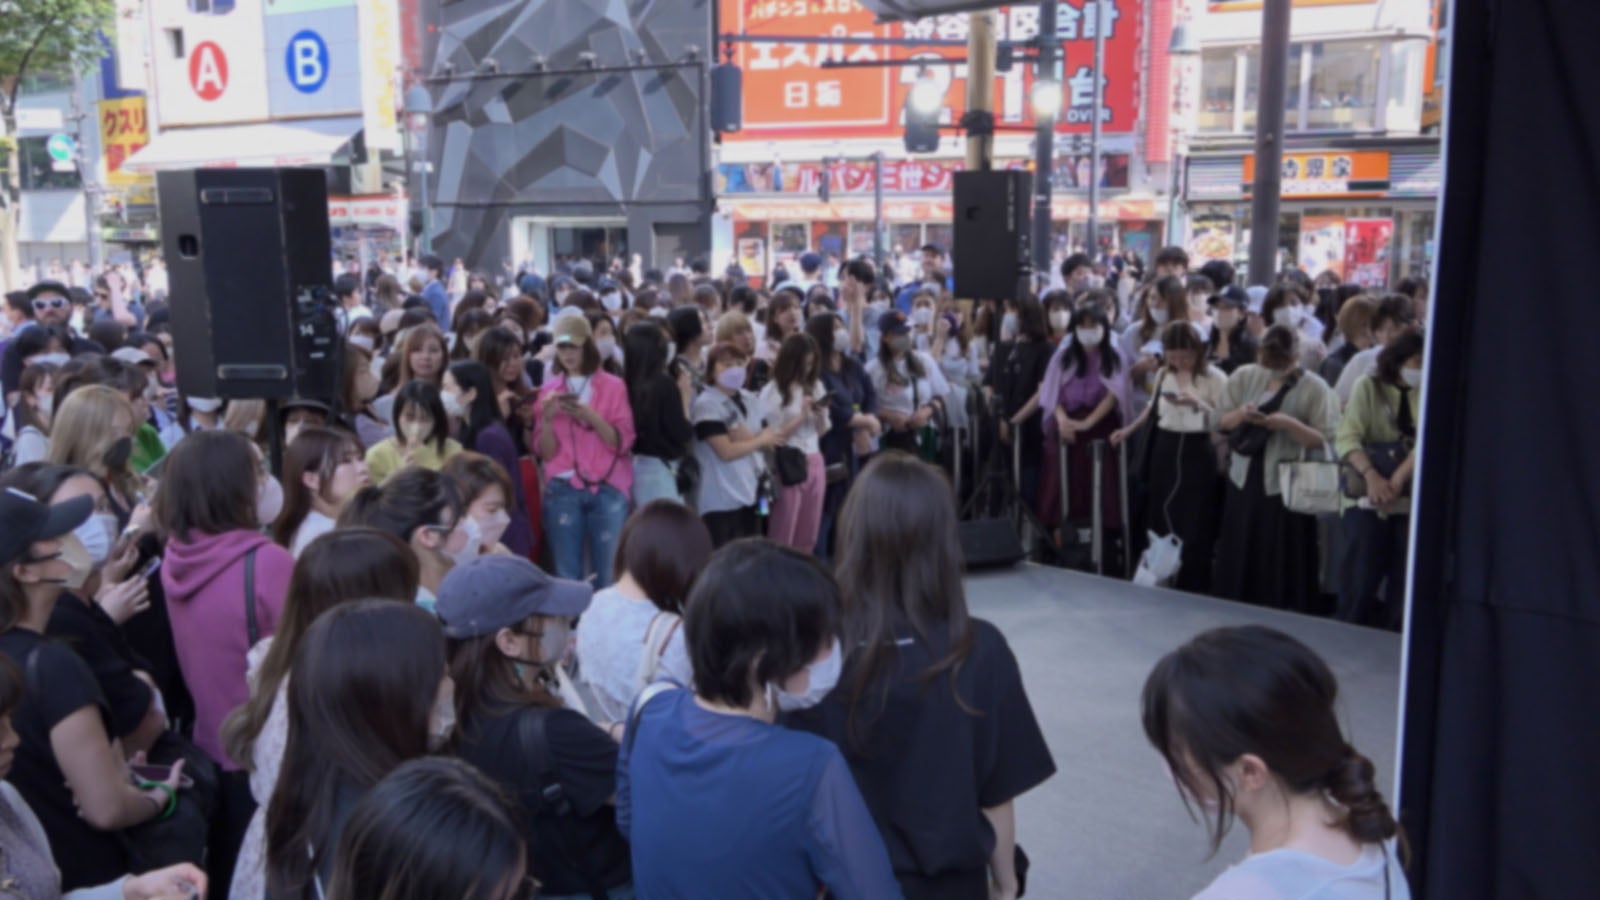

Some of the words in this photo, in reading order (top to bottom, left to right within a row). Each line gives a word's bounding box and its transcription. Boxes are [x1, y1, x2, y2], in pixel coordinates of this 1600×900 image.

[197, 47, 223, 90] A
[295, 39, 321, 84] B
[104, 108, 147, 137] クスリ
[1067, 109, 1111, 123] OVR
[800, 158, 963, 191] ルパン三世シ
